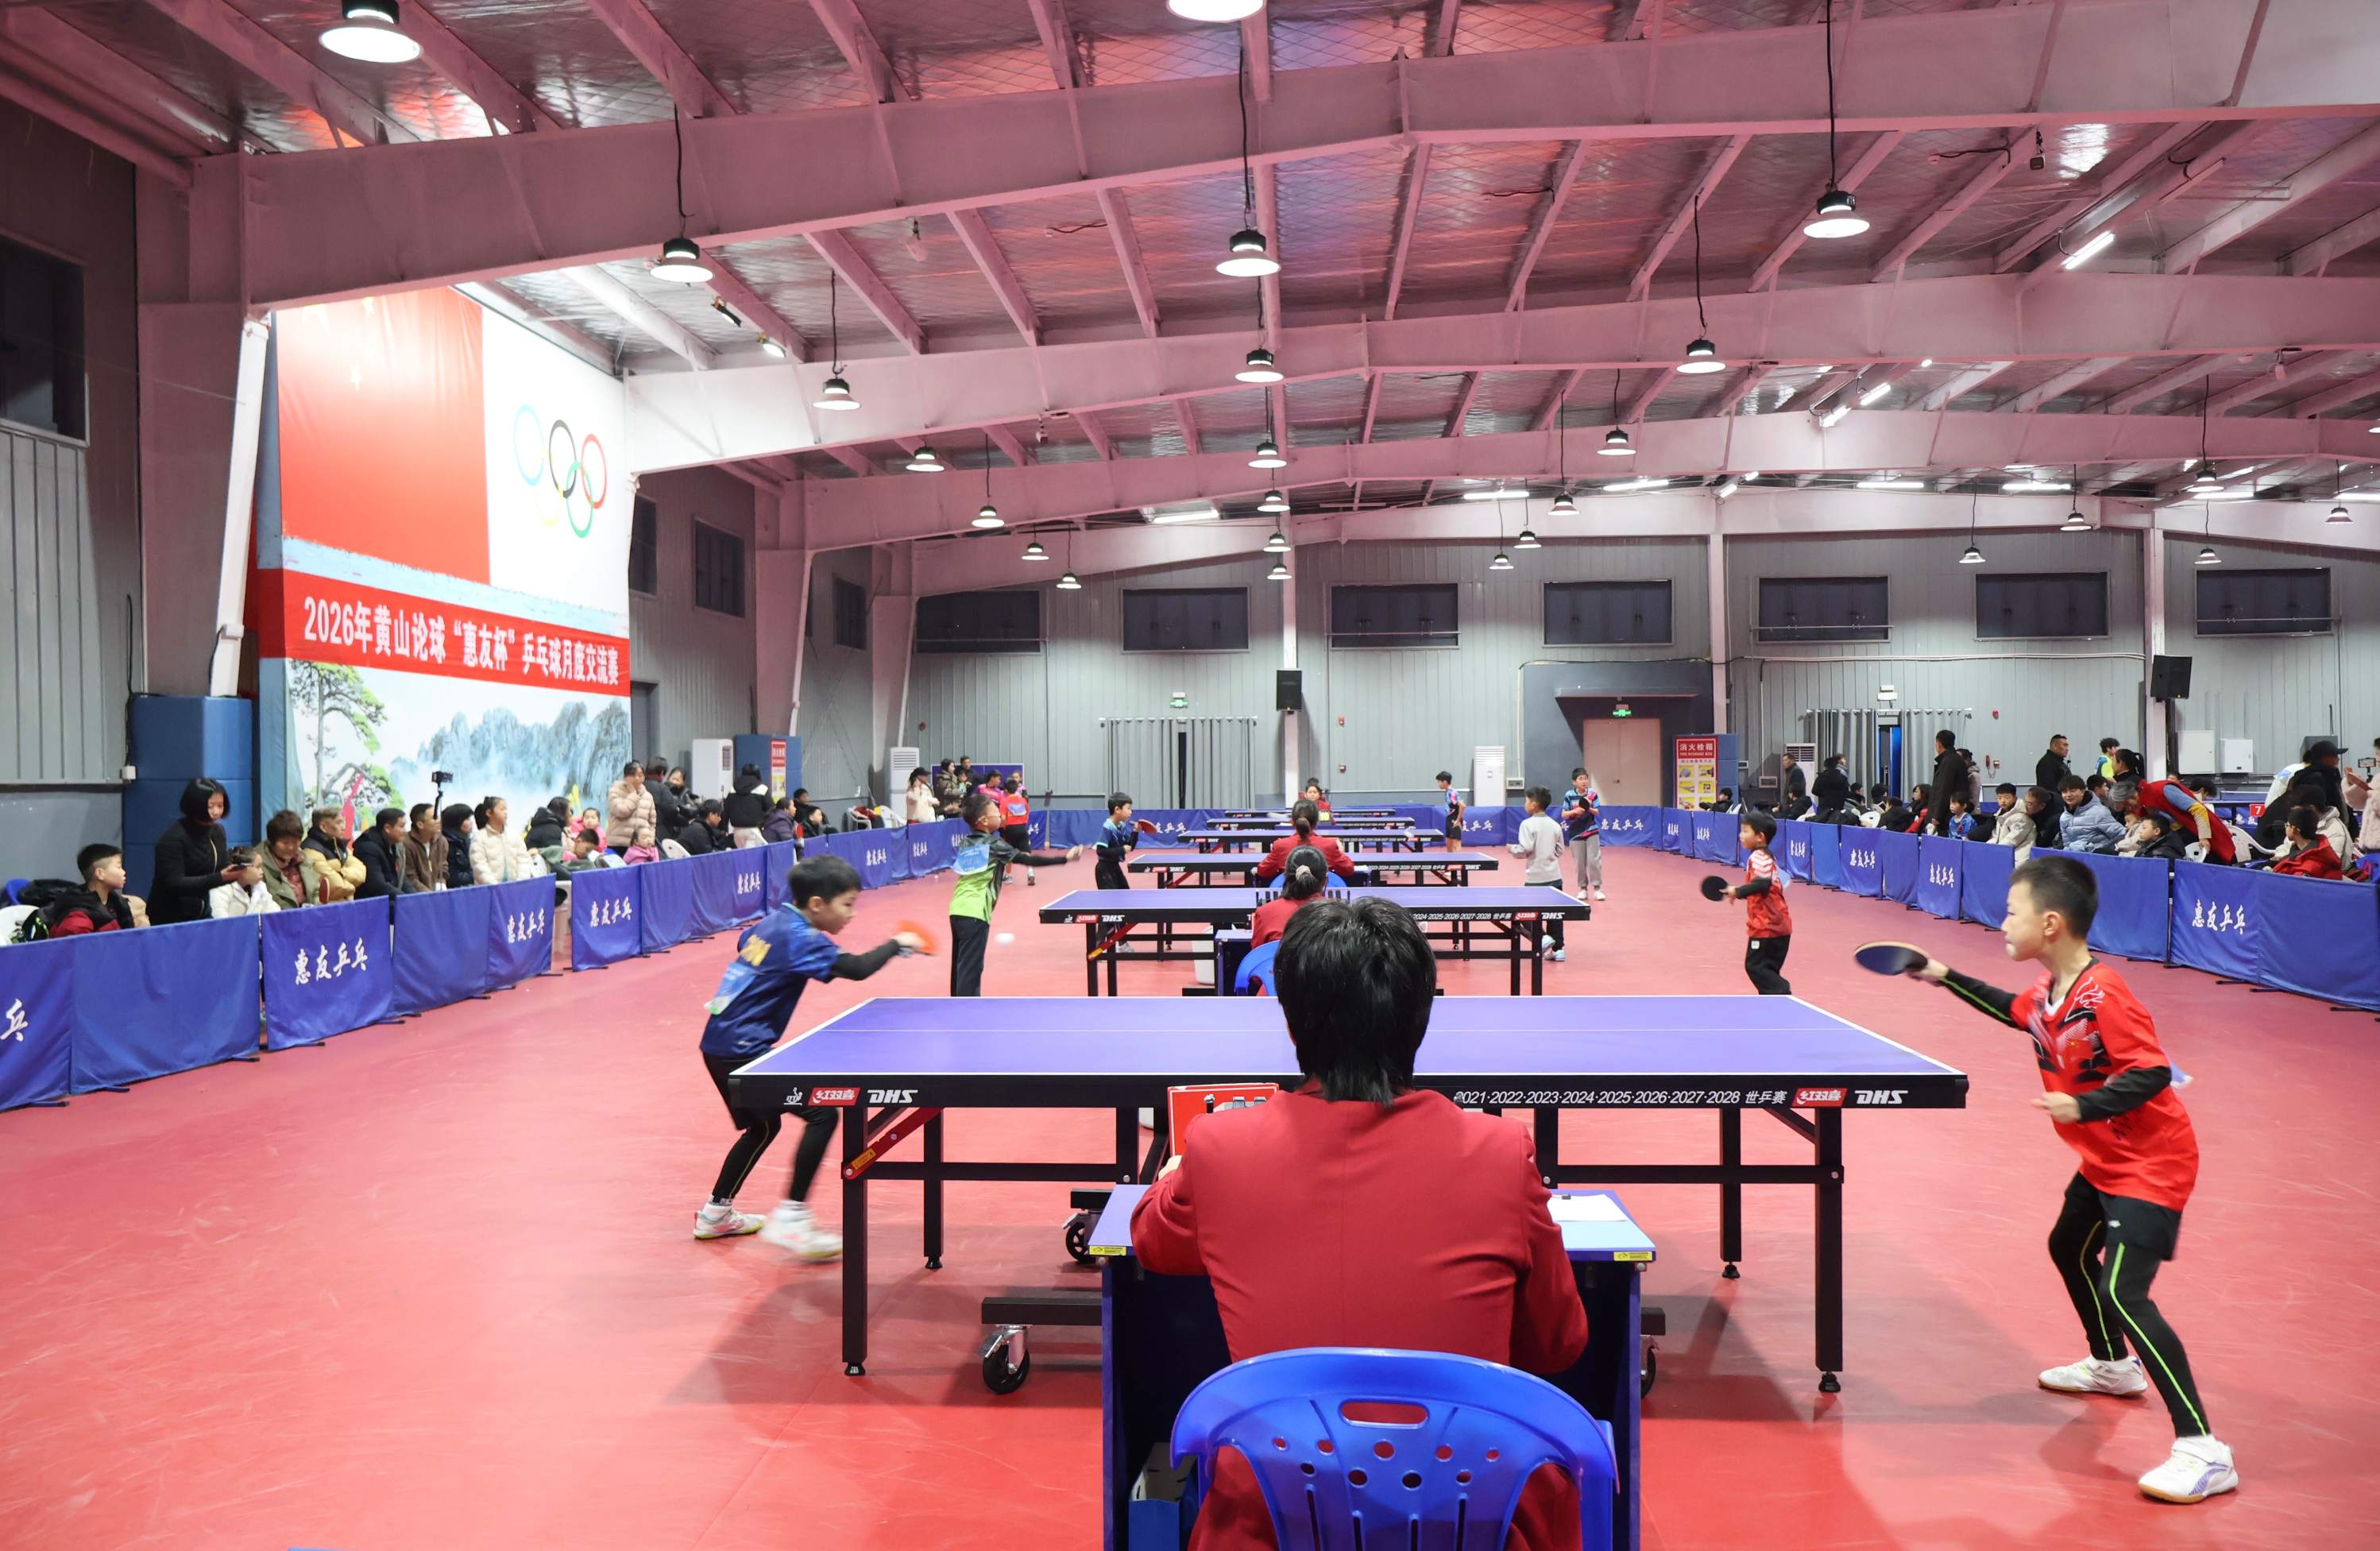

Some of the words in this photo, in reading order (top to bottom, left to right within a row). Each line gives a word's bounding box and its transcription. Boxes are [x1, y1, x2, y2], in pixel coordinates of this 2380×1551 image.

[2254, 806, 2262, 815] 7
[1601, 818, 1644, 831] 惠友乒乓
[1849, 848, 1876, 869] 惠友乒乓
[1929, 862, 1955, 888] 惠友乒乓
[589, 896, 632, 927] 惠友乒乓
[2192, 899, 2246, 935] 惠友乒乓
[507, 907, 545, 944] 惠友乒乓
[295, 937, 369, 985] 惠友乒乓
[813, 1089, 856, 1104] 红双喜
[867, 1089, 918, 1104] DHS
[1745, 1090, 1787, 1104] 世乒赛
[1796, 1089, 1842, 1105] 红双喜
[1854, 1090, 1908, 1104] DHS
